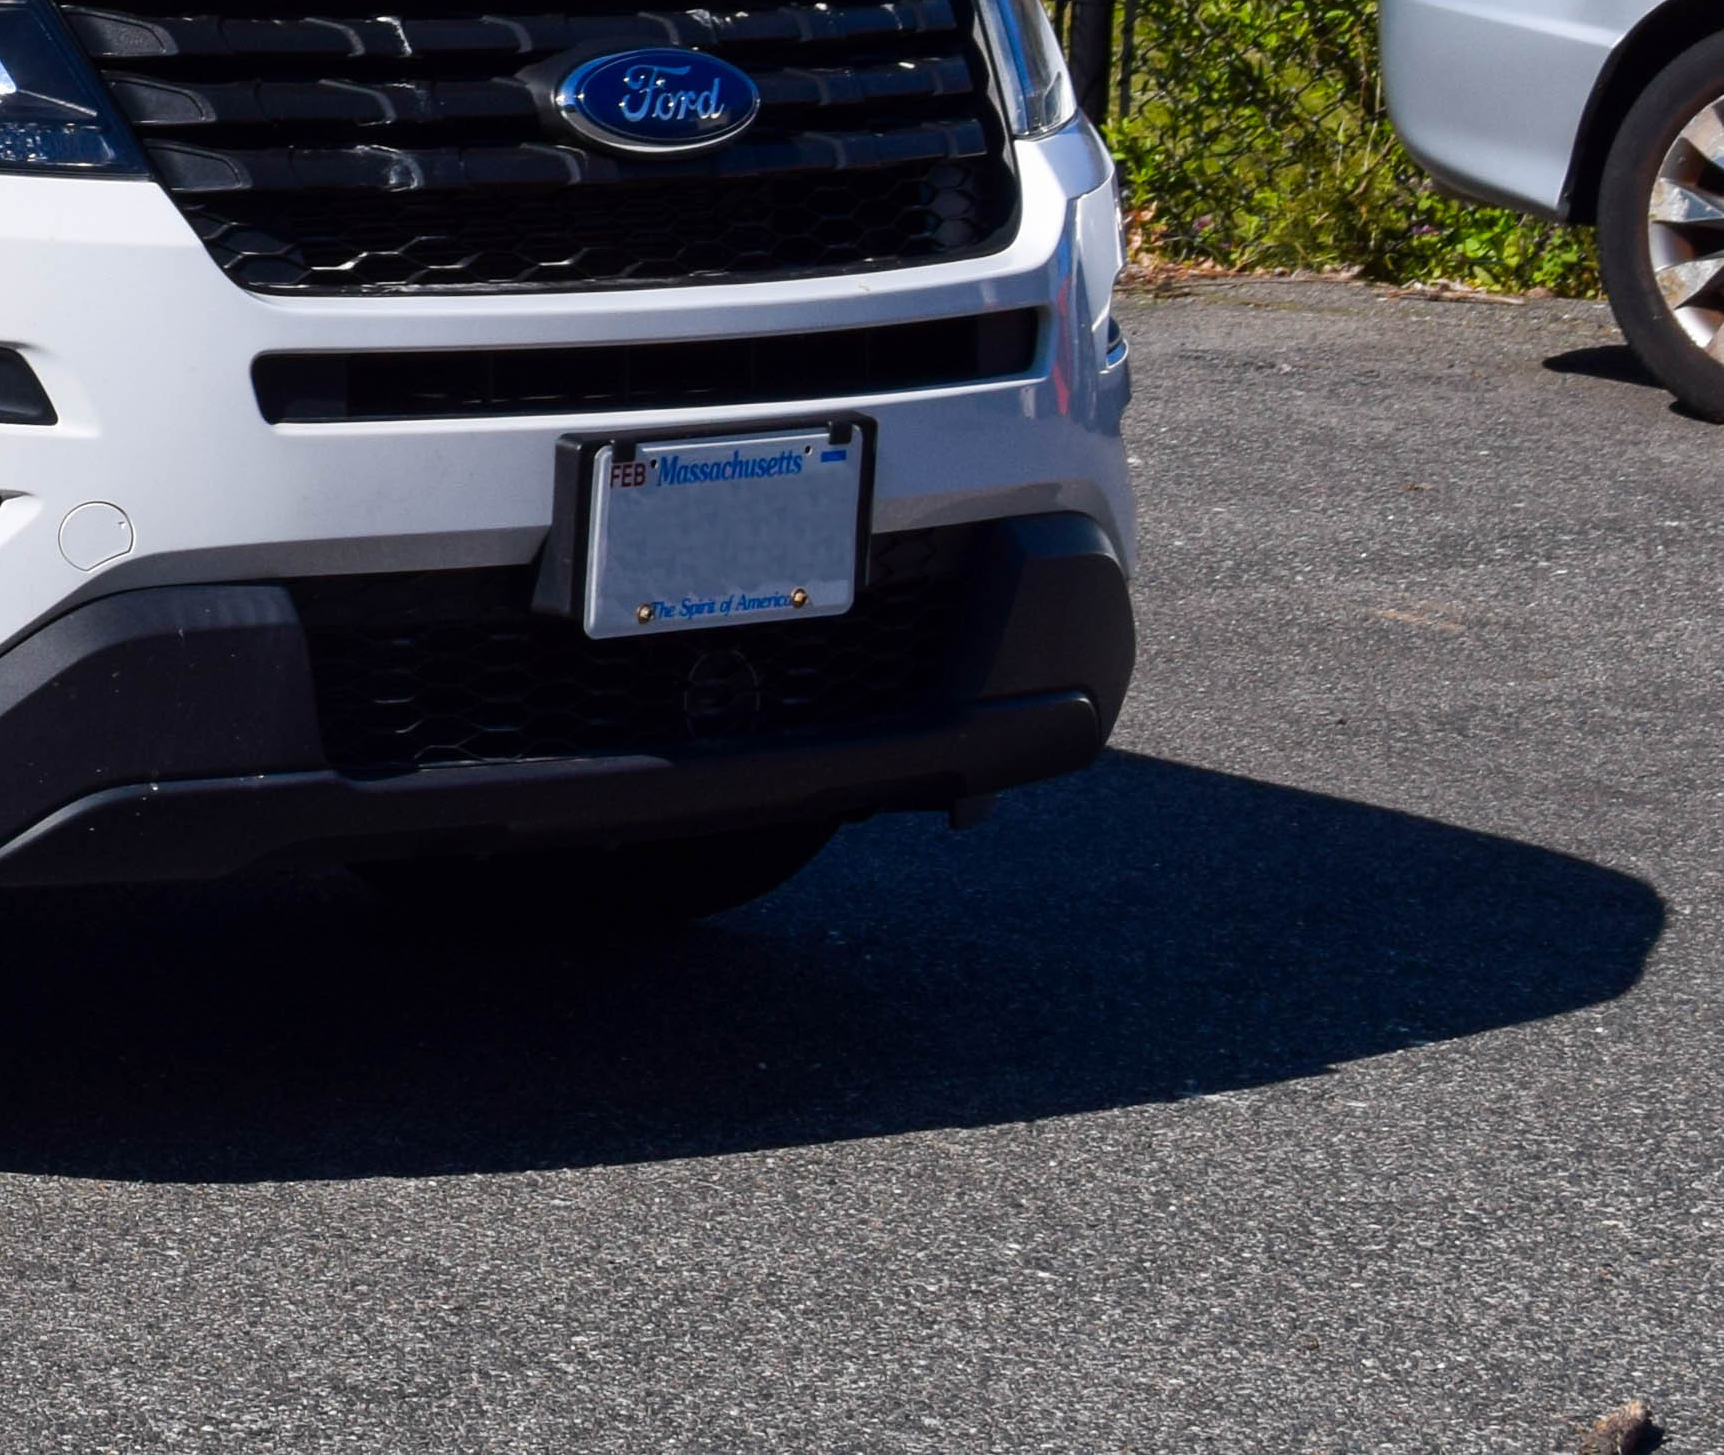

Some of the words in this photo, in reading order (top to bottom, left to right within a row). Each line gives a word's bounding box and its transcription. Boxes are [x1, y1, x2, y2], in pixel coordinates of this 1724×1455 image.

[617, 64, 725, 122] Ford
[610, 462, 647, 489] FEB
[657, 450, 803, 487] Massachusetts
[720, 594, 734, 617] of
